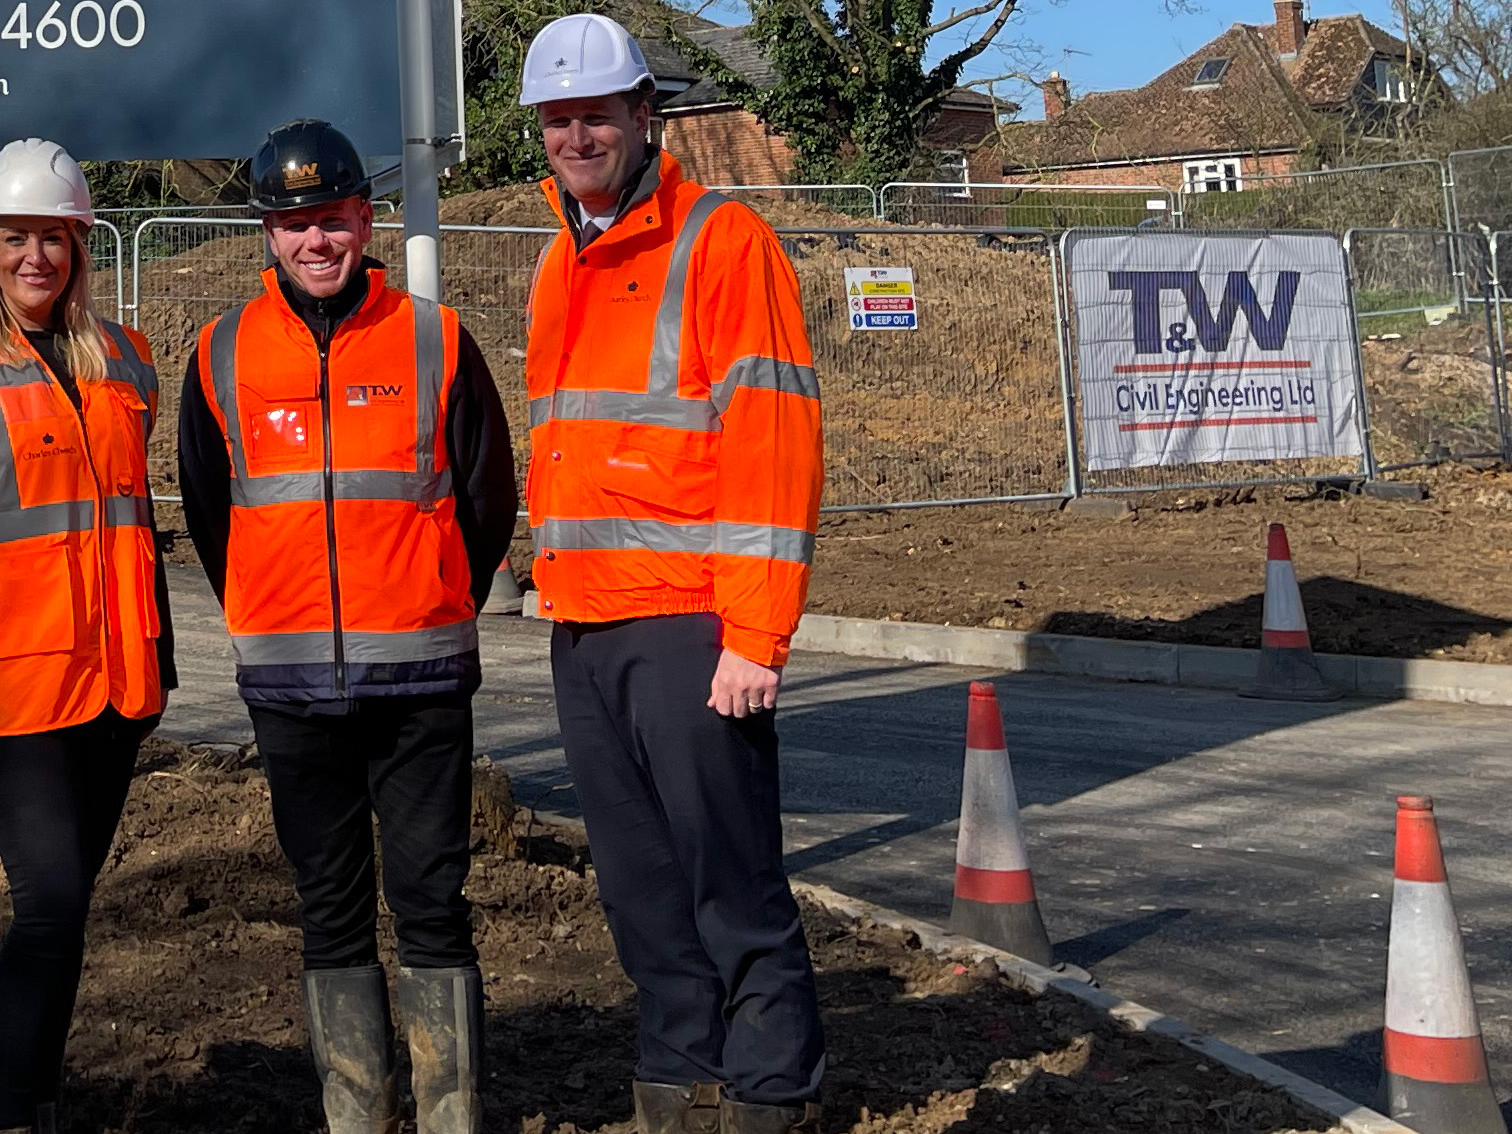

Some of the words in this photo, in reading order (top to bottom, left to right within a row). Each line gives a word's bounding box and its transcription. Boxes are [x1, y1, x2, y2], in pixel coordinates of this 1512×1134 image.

[871, 316, 892, 324] KEEP
[893, 316, 909, 324] OUT
[1108, 271, 1301, 354] T&W
[1116, 383, 1159, 412] Civil
[1165, 380, 1283, 415] Engineering
[1289, 379, 1315, 405] Ltd
